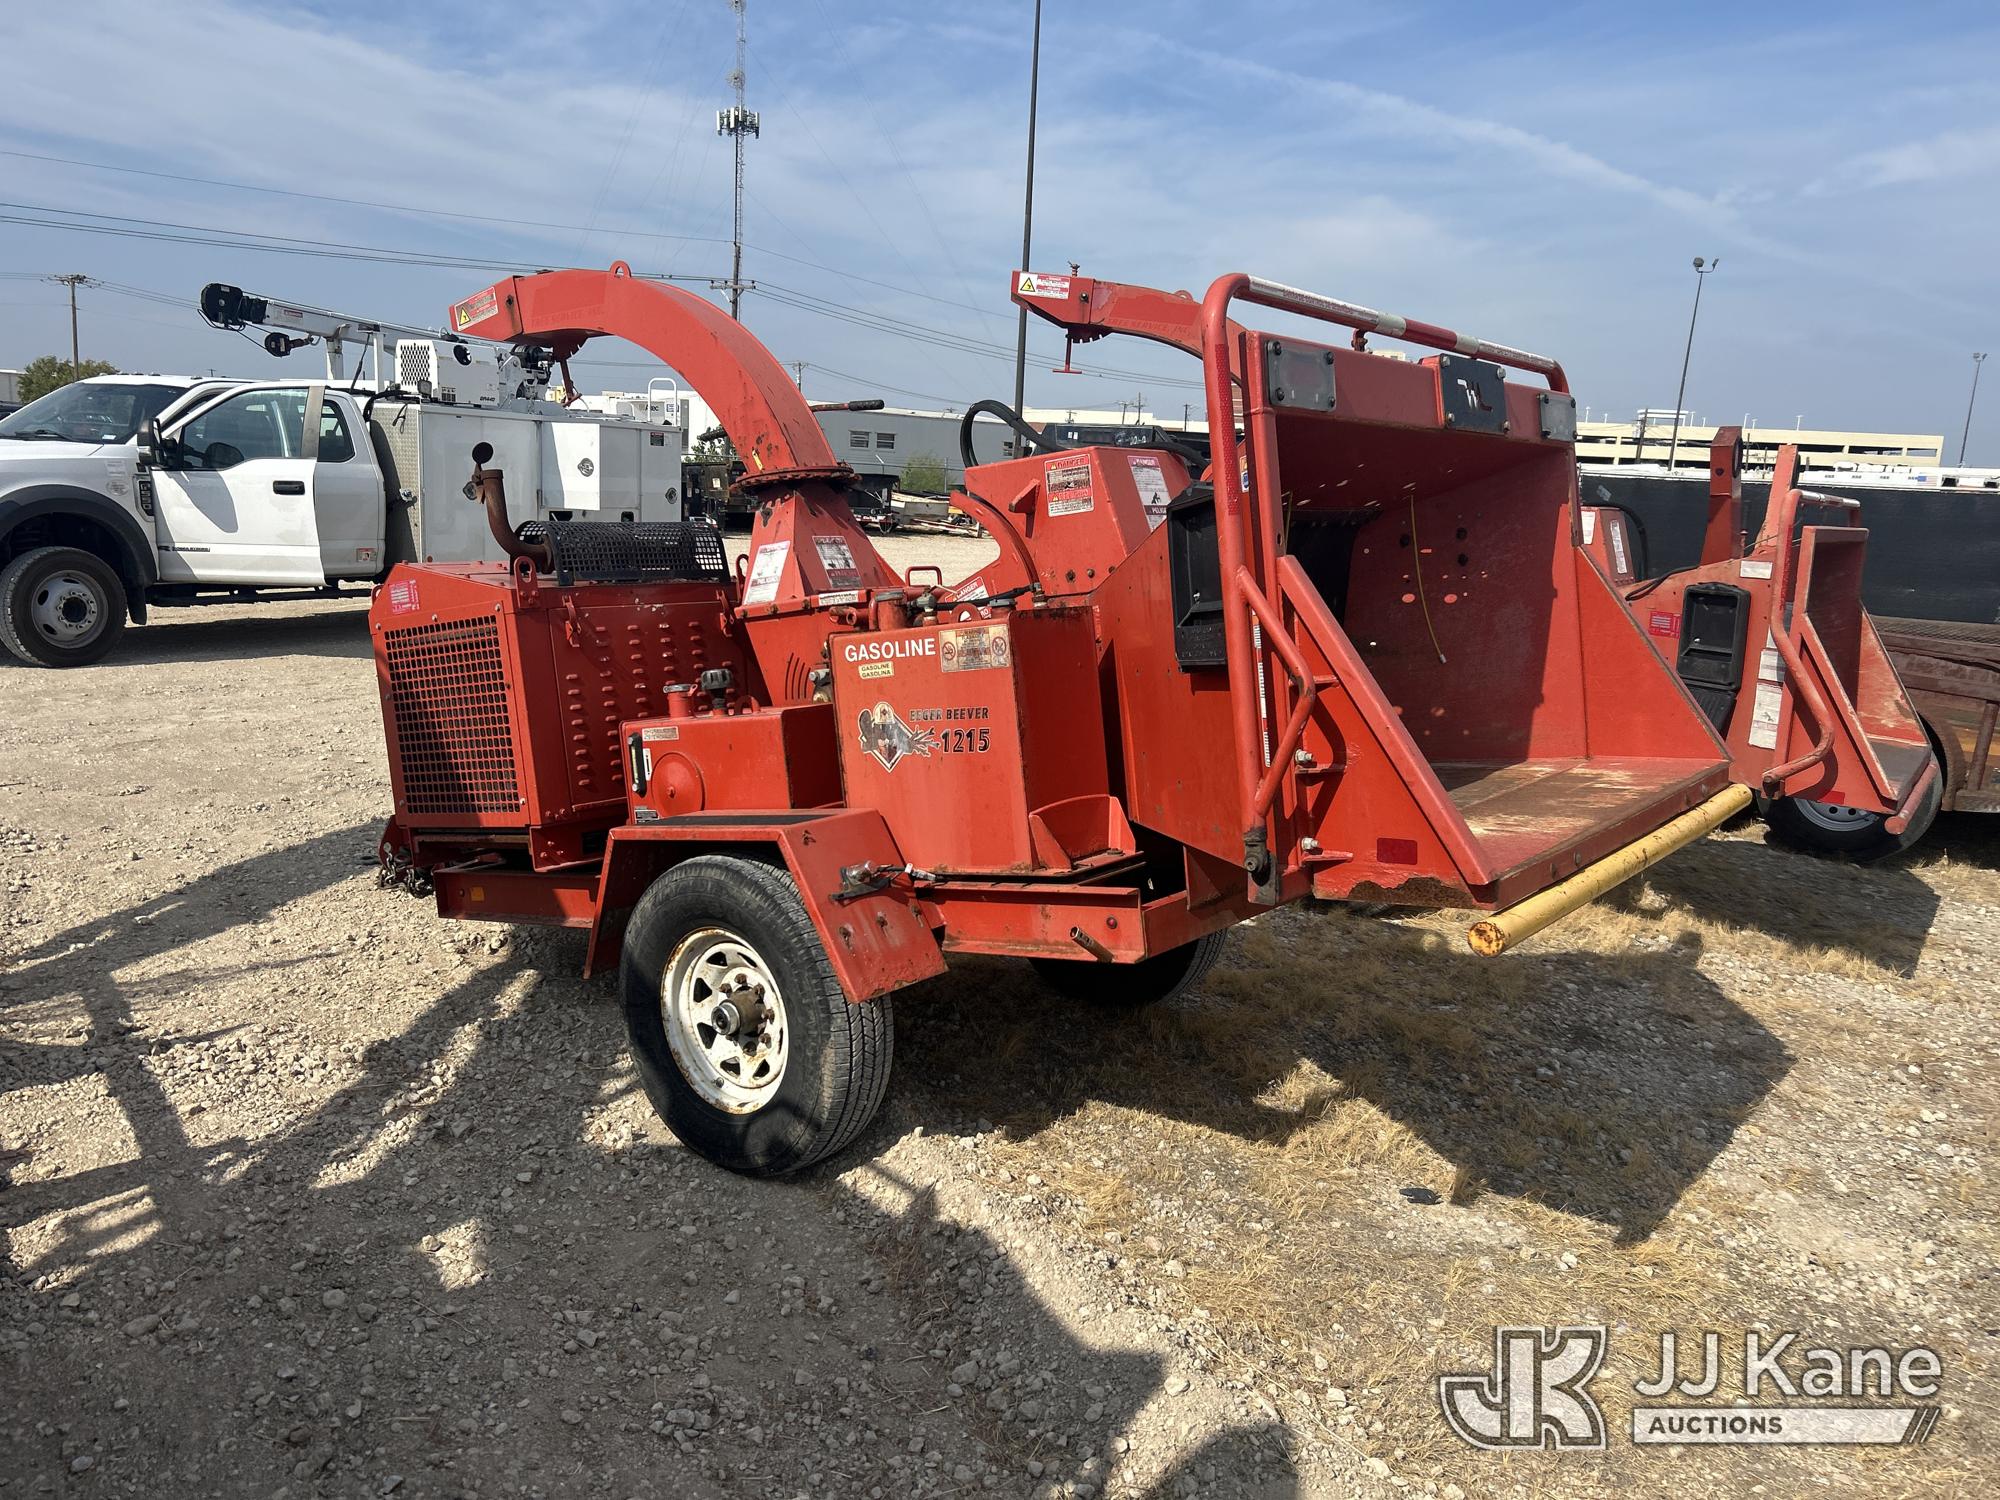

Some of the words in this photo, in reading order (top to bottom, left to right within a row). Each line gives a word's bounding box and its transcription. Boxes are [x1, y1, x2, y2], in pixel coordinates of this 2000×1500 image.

[844, 638, 936, 662] GASOLINE
[861, 663, 890, 672] GASOLINE
[946, 707, 989, 720] BEEVER
[941, 728, 990, 753] 1215
